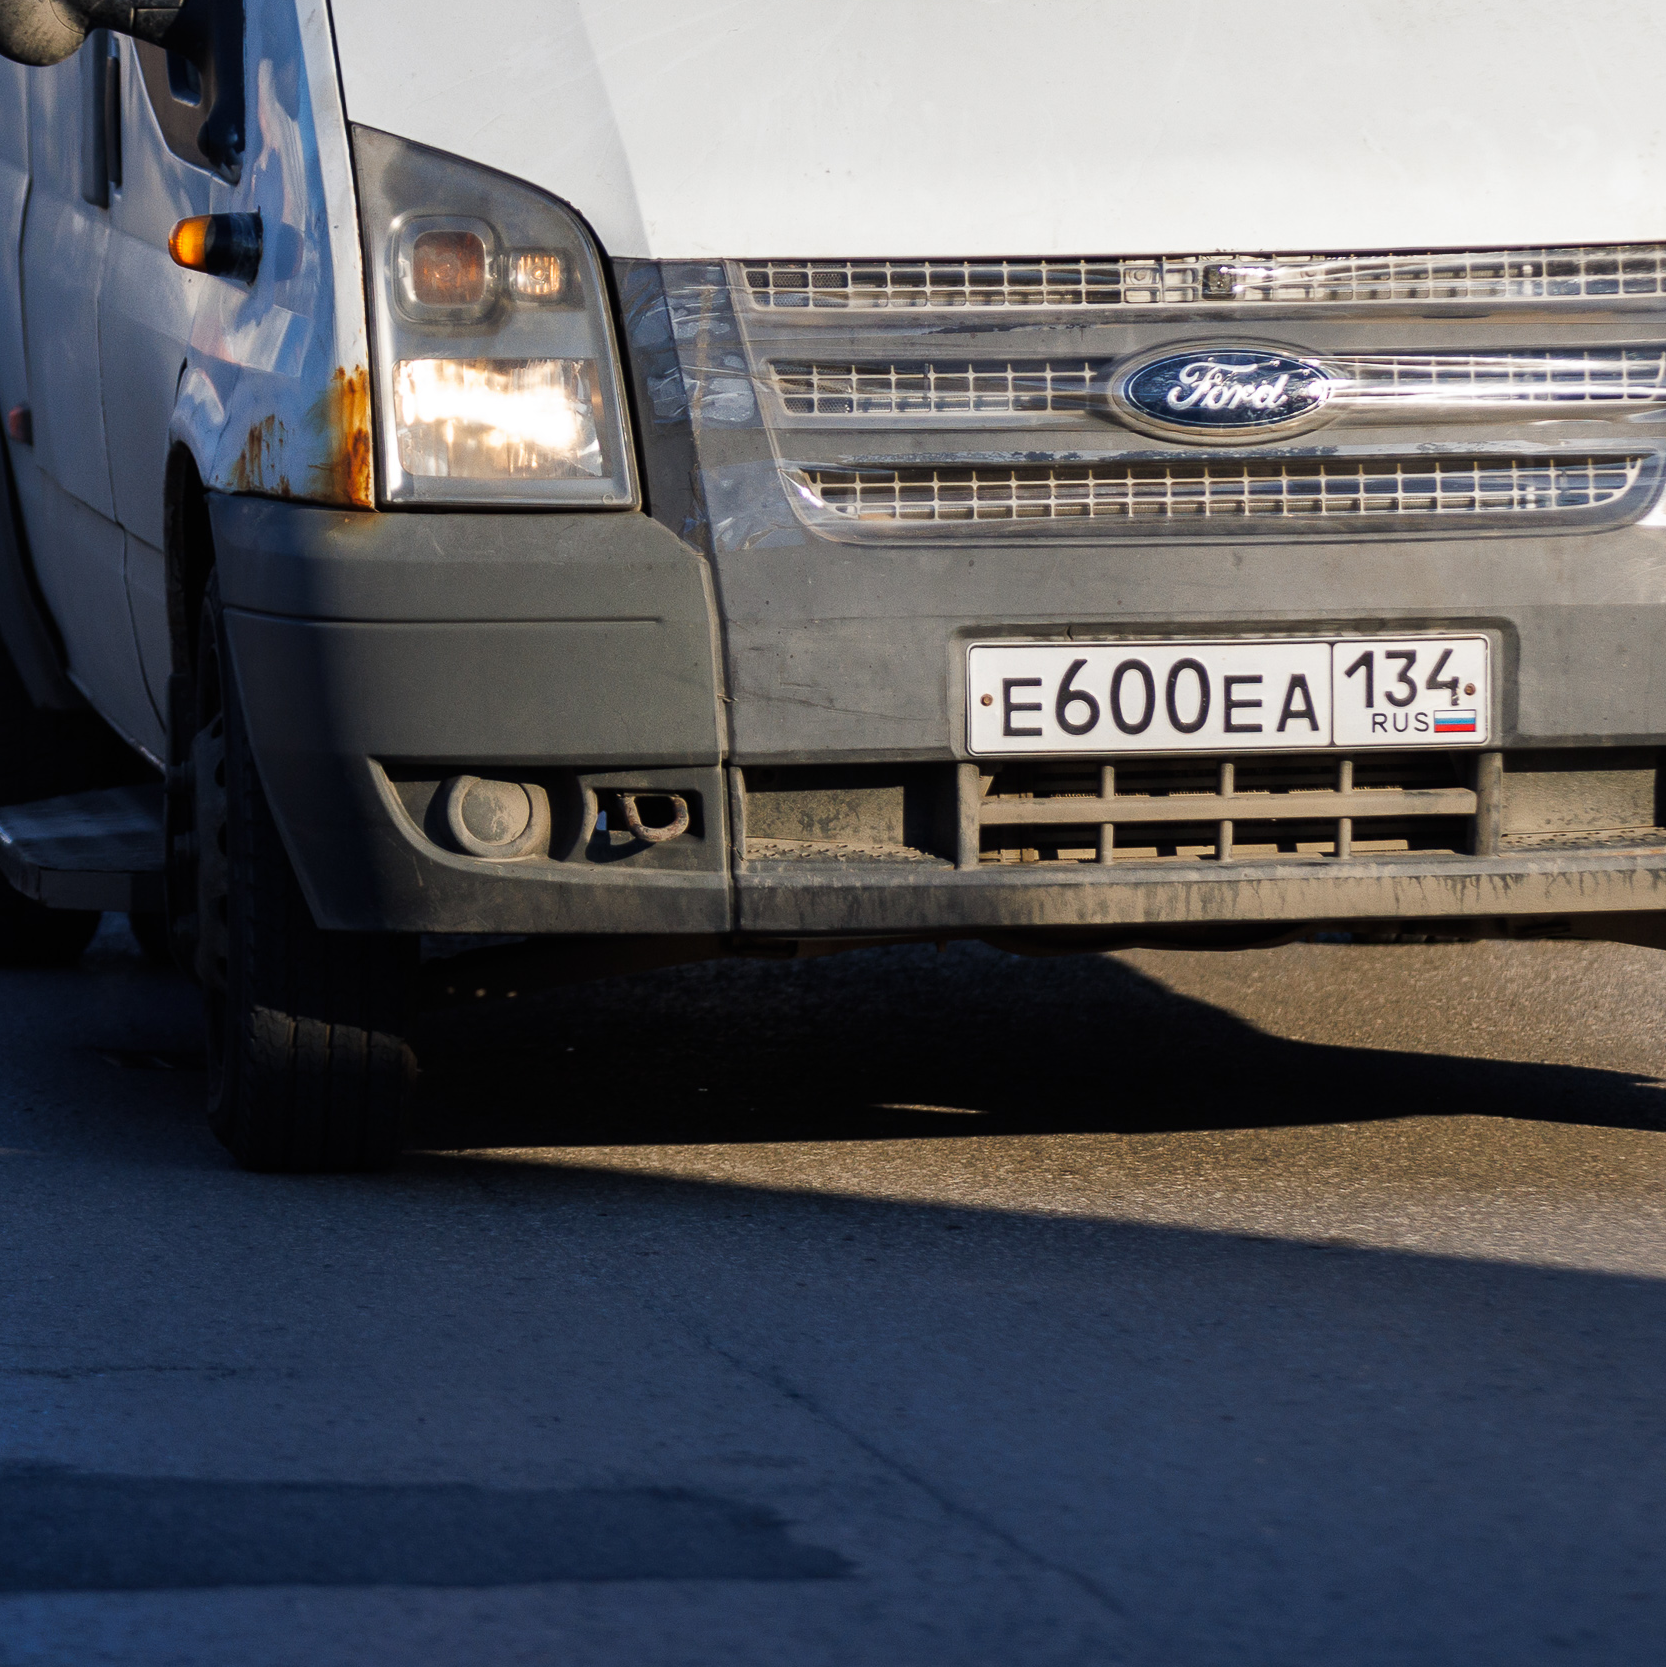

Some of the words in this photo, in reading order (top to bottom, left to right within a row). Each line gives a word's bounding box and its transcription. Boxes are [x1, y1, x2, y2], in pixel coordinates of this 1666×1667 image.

[1166, 361, 1290, 411] Ford
[1002, 657, 1320, 738] Е600ЕА
[1344, 648, 1461, 709] 134
[1371, 711, 1430, 734] RUS
